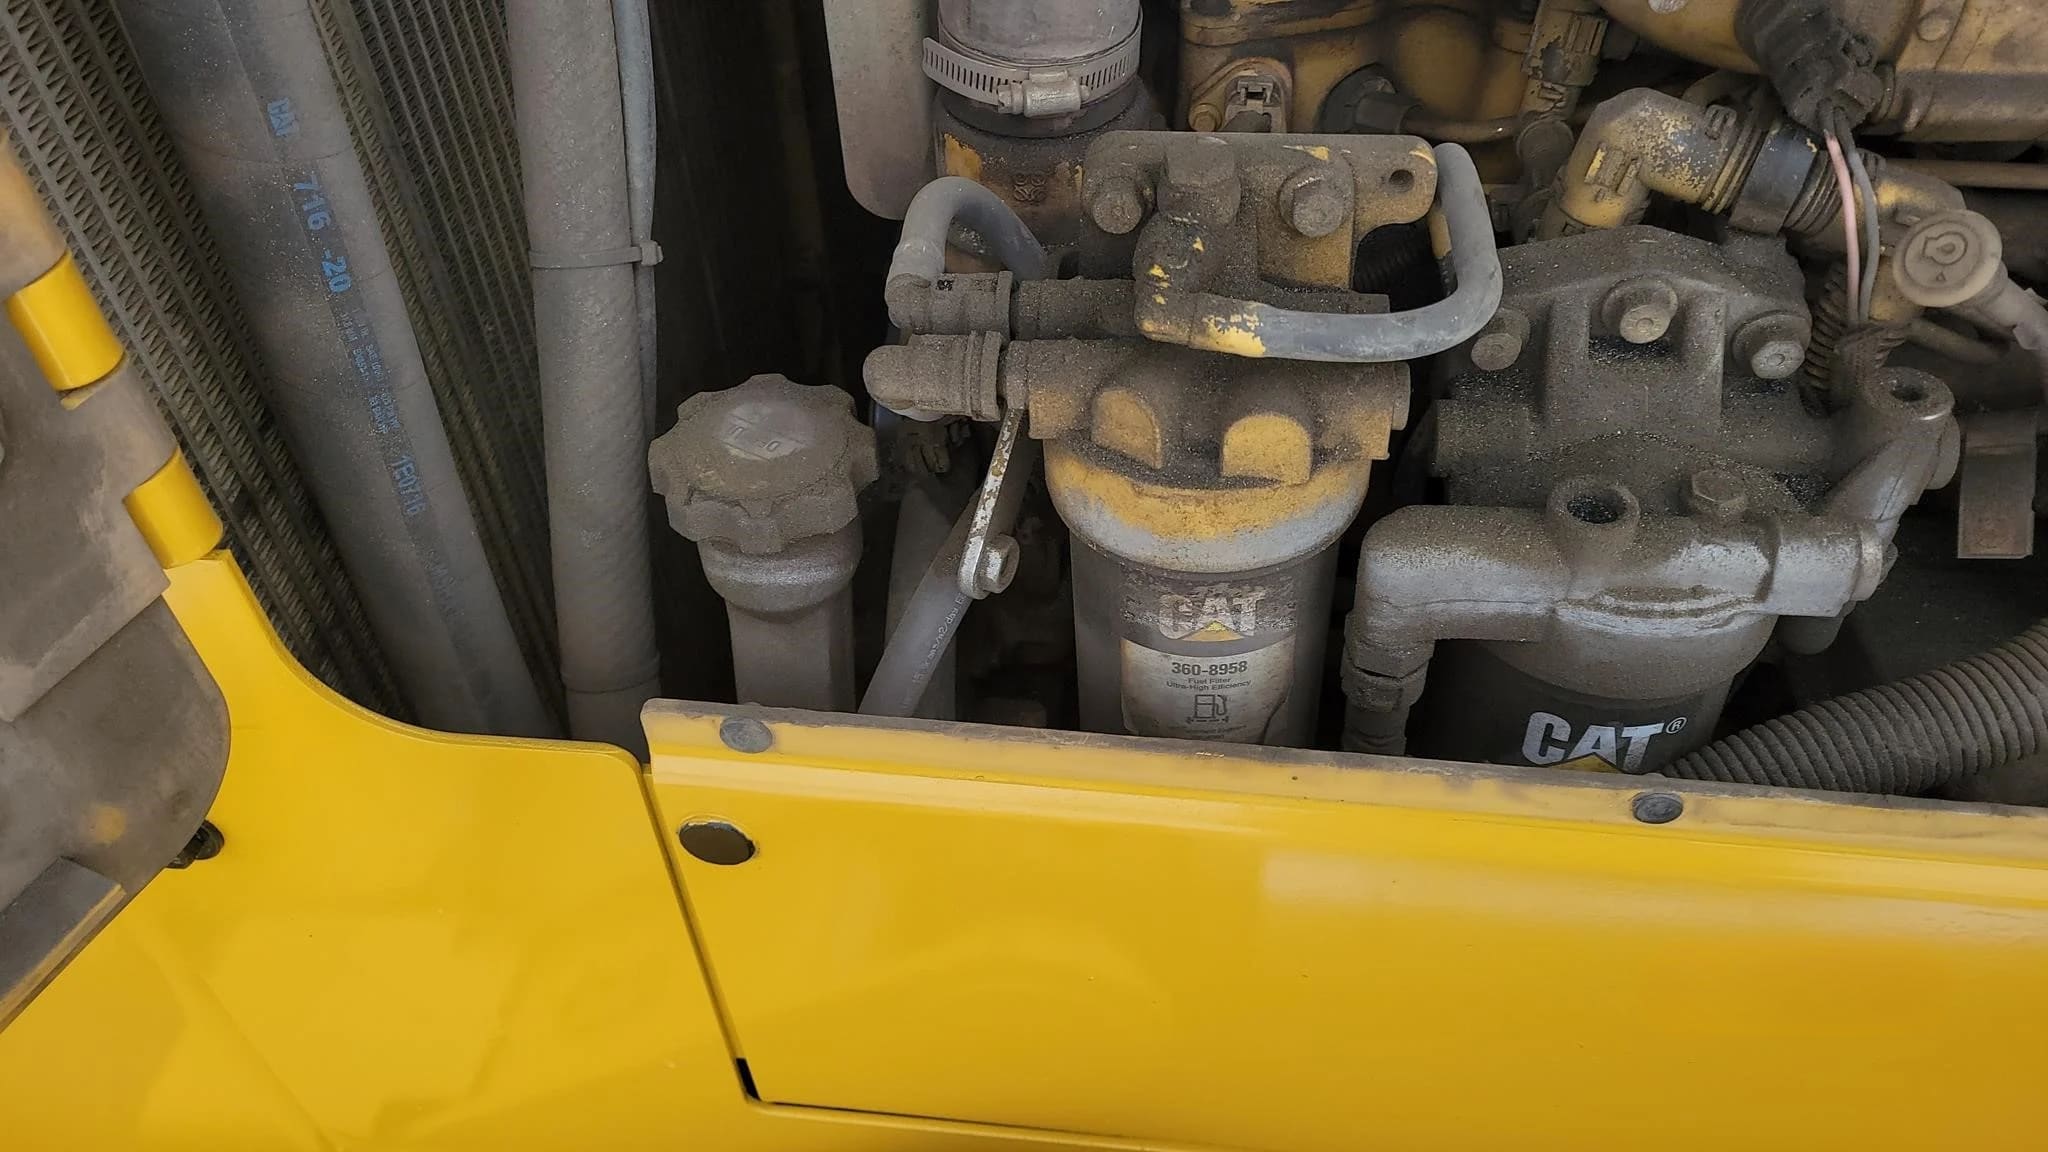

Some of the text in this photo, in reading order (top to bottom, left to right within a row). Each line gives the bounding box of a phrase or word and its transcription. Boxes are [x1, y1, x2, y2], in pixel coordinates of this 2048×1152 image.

[1158, 586, 1268, 639] CAT
[1171, 660, 1248, 676] 360-8958
[1166, 680, 1251, 691] Ultra-High Efficiency
